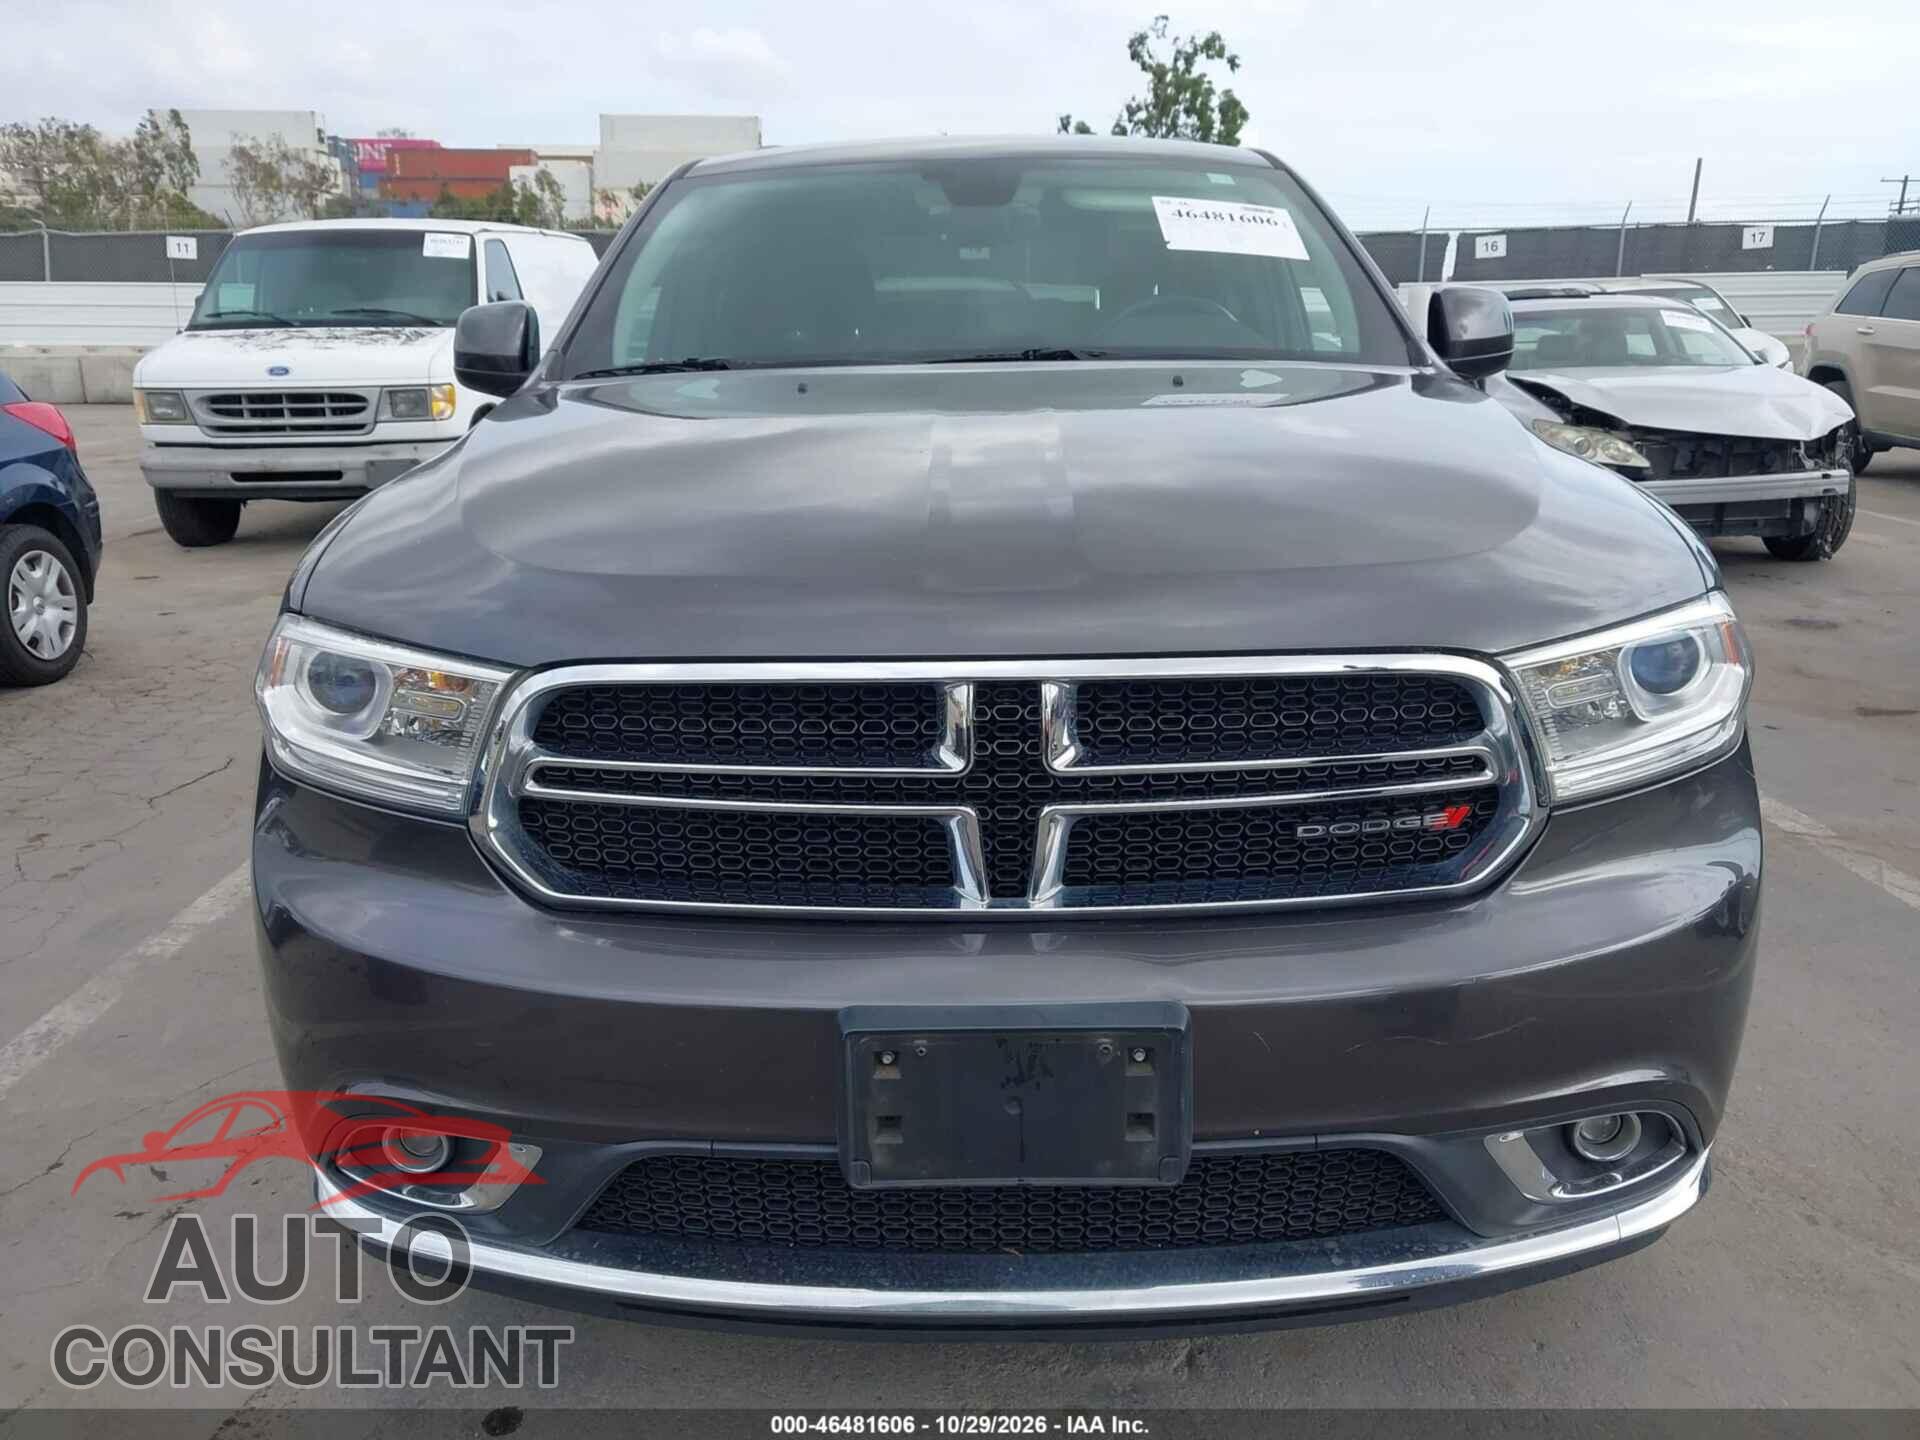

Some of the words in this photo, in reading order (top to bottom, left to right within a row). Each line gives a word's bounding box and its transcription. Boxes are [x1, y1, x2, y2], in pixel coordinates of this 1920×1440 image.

[1751, 232, 1766, 243] 17
[175, 242, 189, 255] 11
[1484, 240, 1498, 252] 16
[1297, 812, 1450, 838] DODGE
